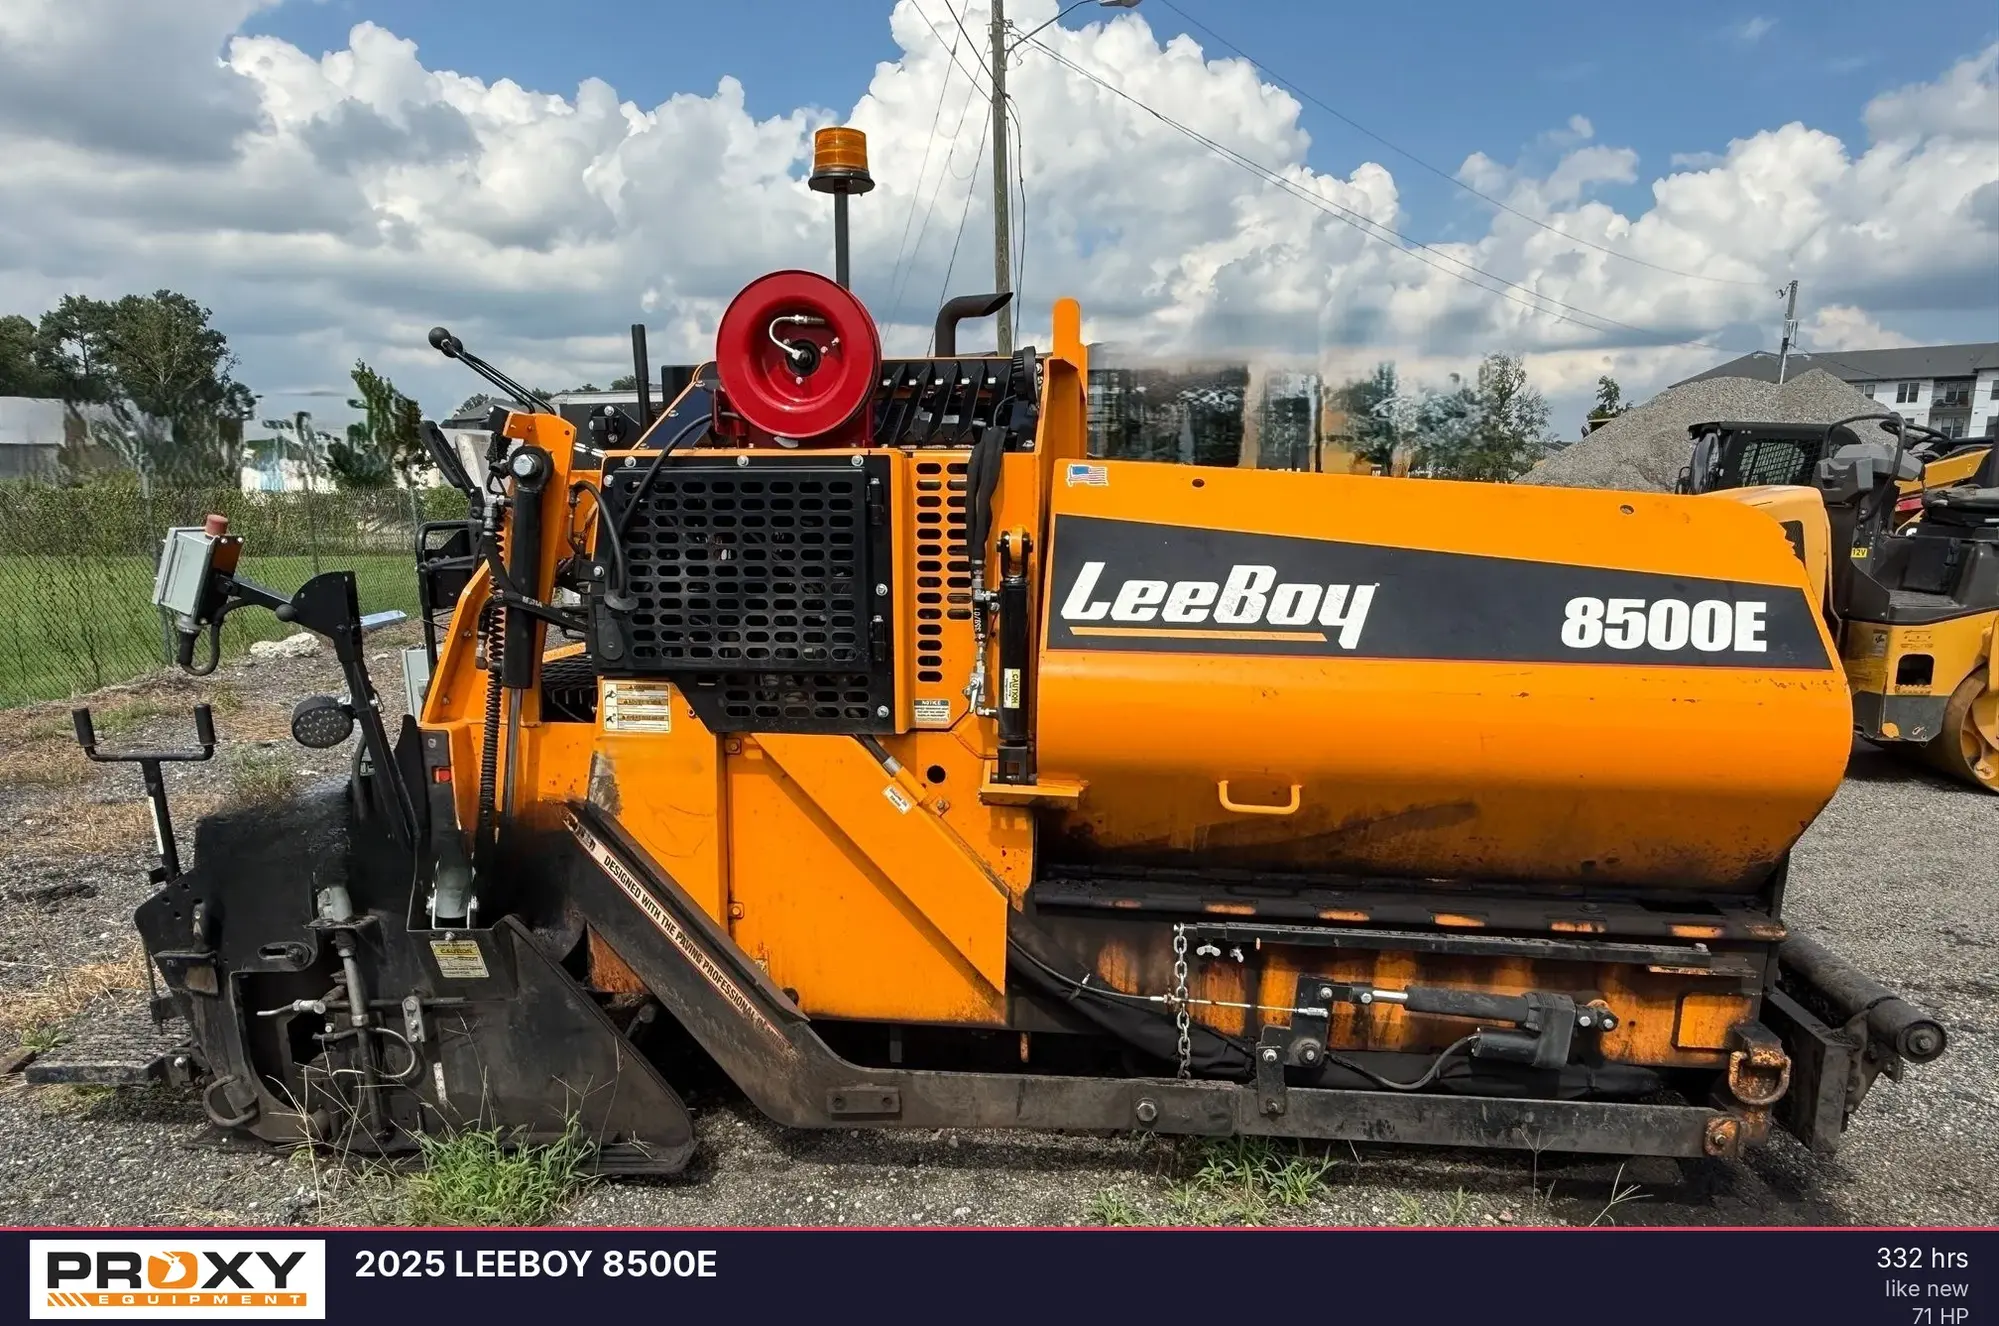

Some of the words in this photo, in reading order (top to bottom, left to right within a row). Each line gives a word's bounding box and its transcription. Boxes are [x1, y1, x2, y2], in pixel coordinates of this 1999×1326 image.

[1060, 562, 1377, 650] LeeBoy
[1561, 597, 1767, 652] 8500E
[603, 855, 642, 899] DESIGNED
[640, 894, 661, 920] WITH
[660, 914, 677, 935] THE
[675, 932, 703, 964] PAVING
[702, 959, 758, 1020] PROFESSIONAL
